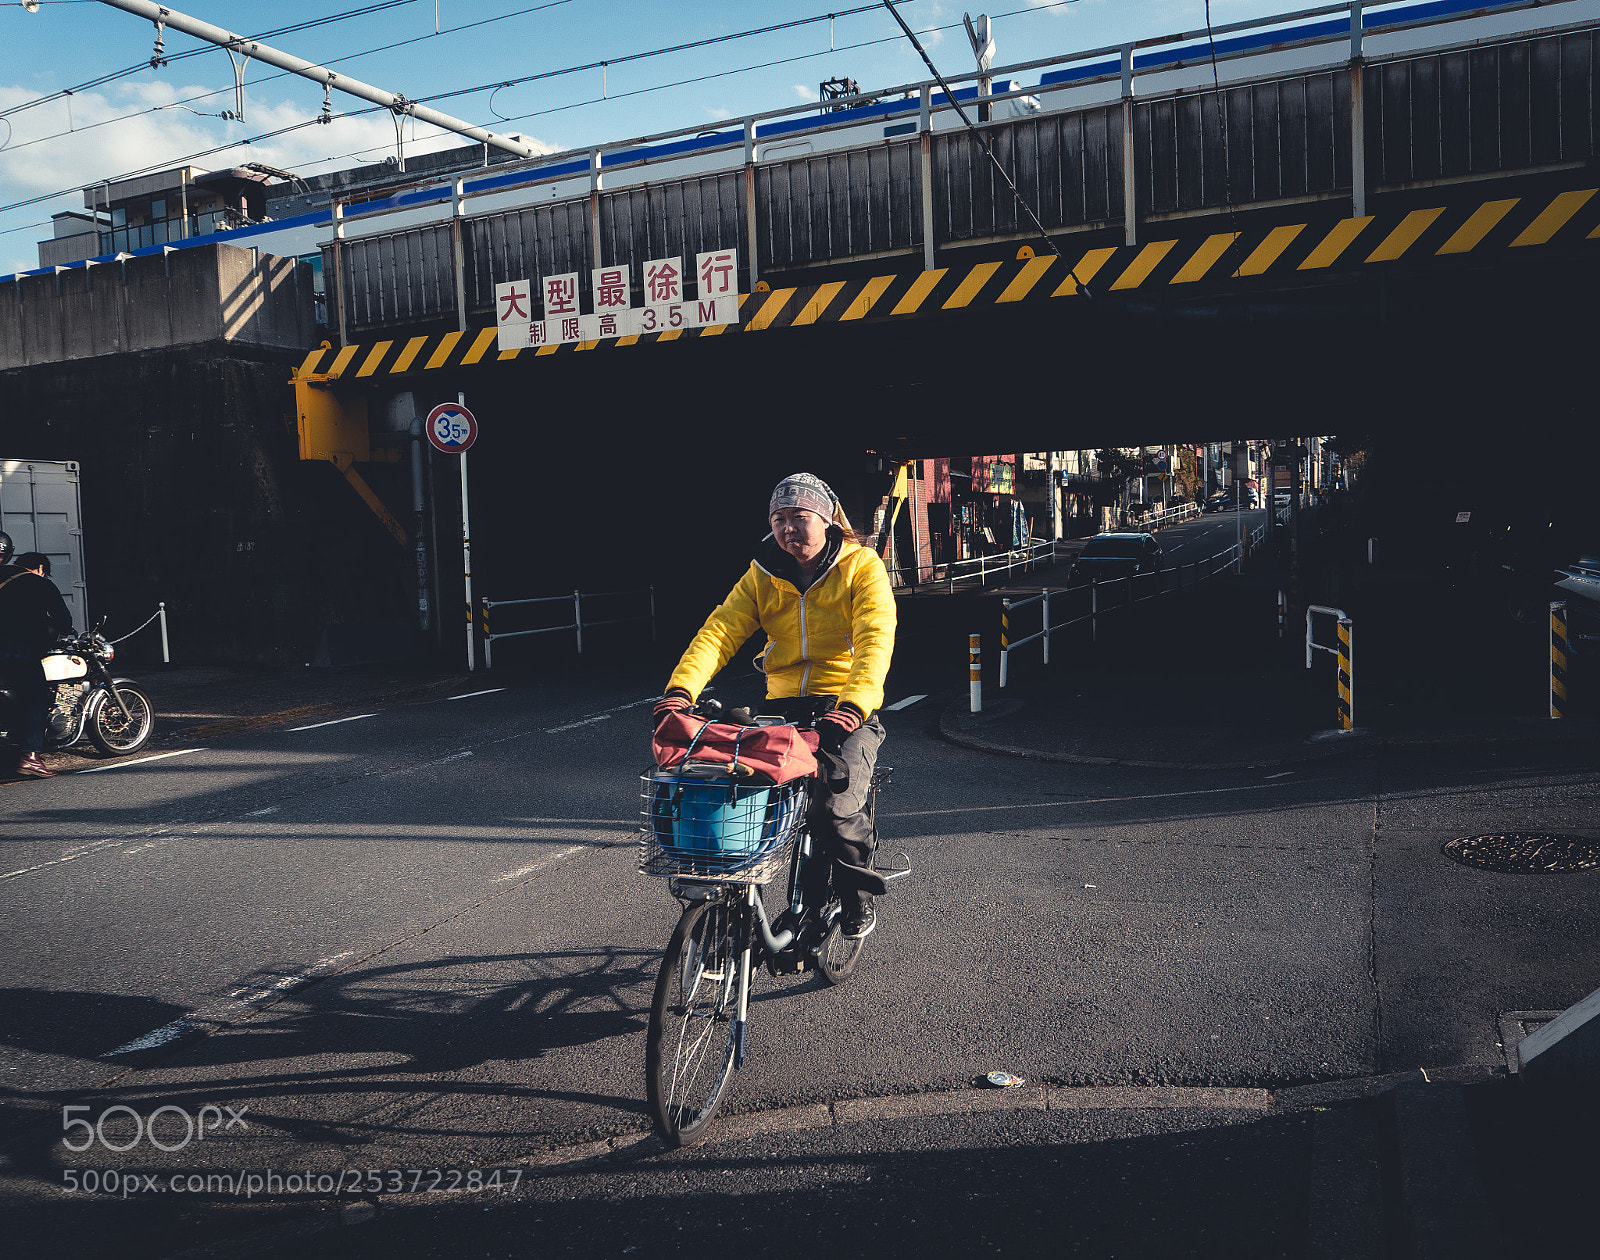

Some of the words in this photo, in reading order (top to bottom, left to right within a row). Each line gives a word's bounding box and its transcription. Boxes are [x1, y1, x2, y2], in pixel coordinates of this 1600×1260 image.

[500, 255, 733, 321] 大型最徐行
